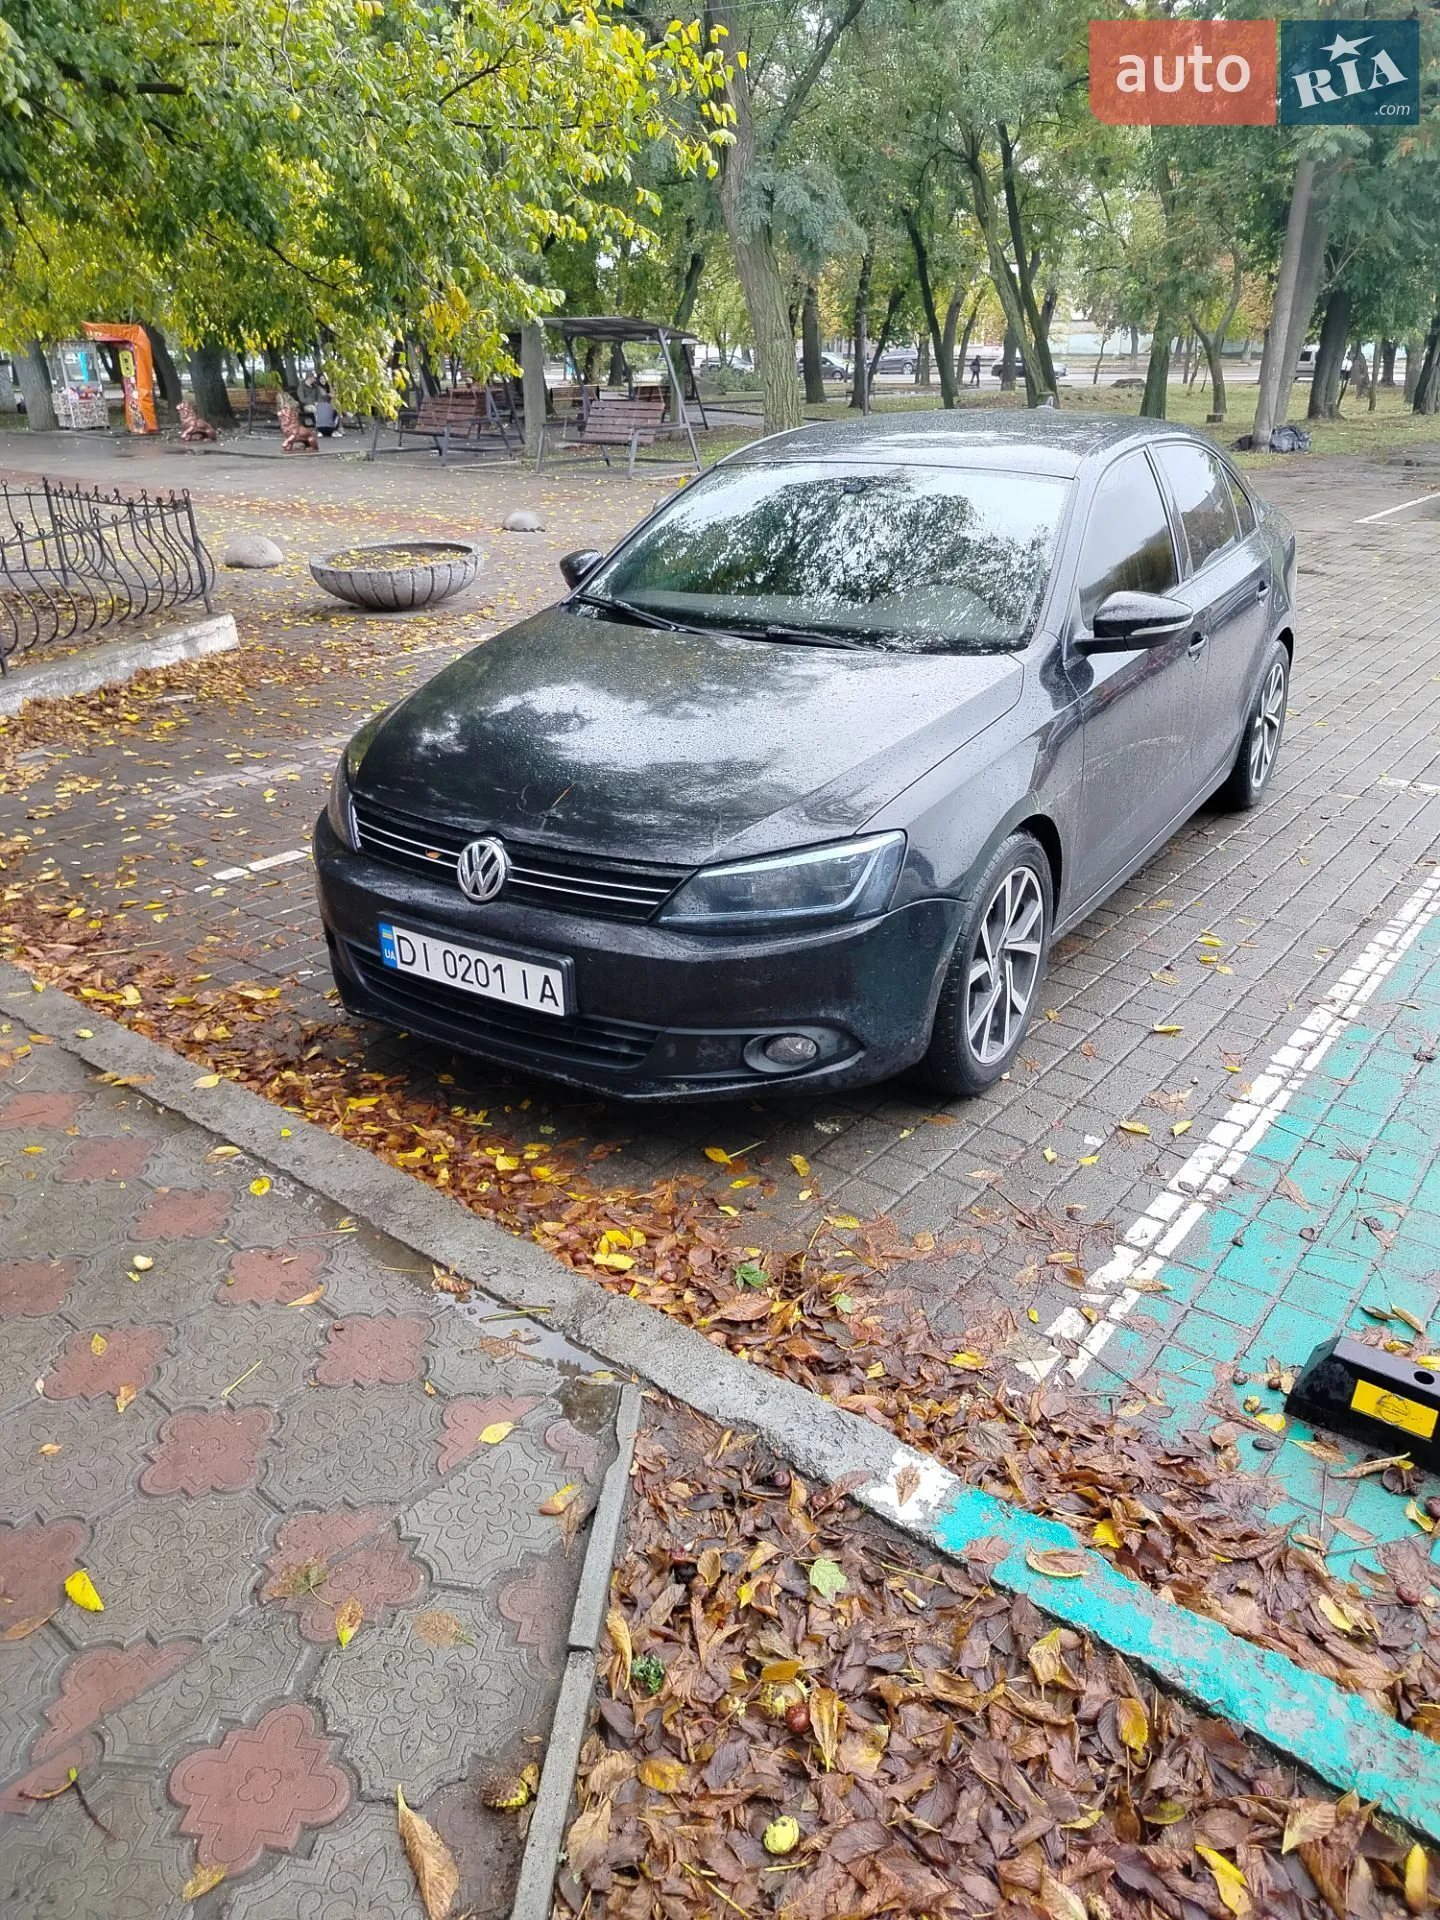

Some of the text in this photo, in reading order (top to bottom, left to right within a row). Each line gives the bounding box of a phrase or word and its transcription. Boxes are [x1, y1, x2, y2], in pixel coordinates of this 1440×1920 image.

[384, 948, 396, 960] UA
[397, 934, 430, 972] DI
[442, 949, 506, 994] 0201
